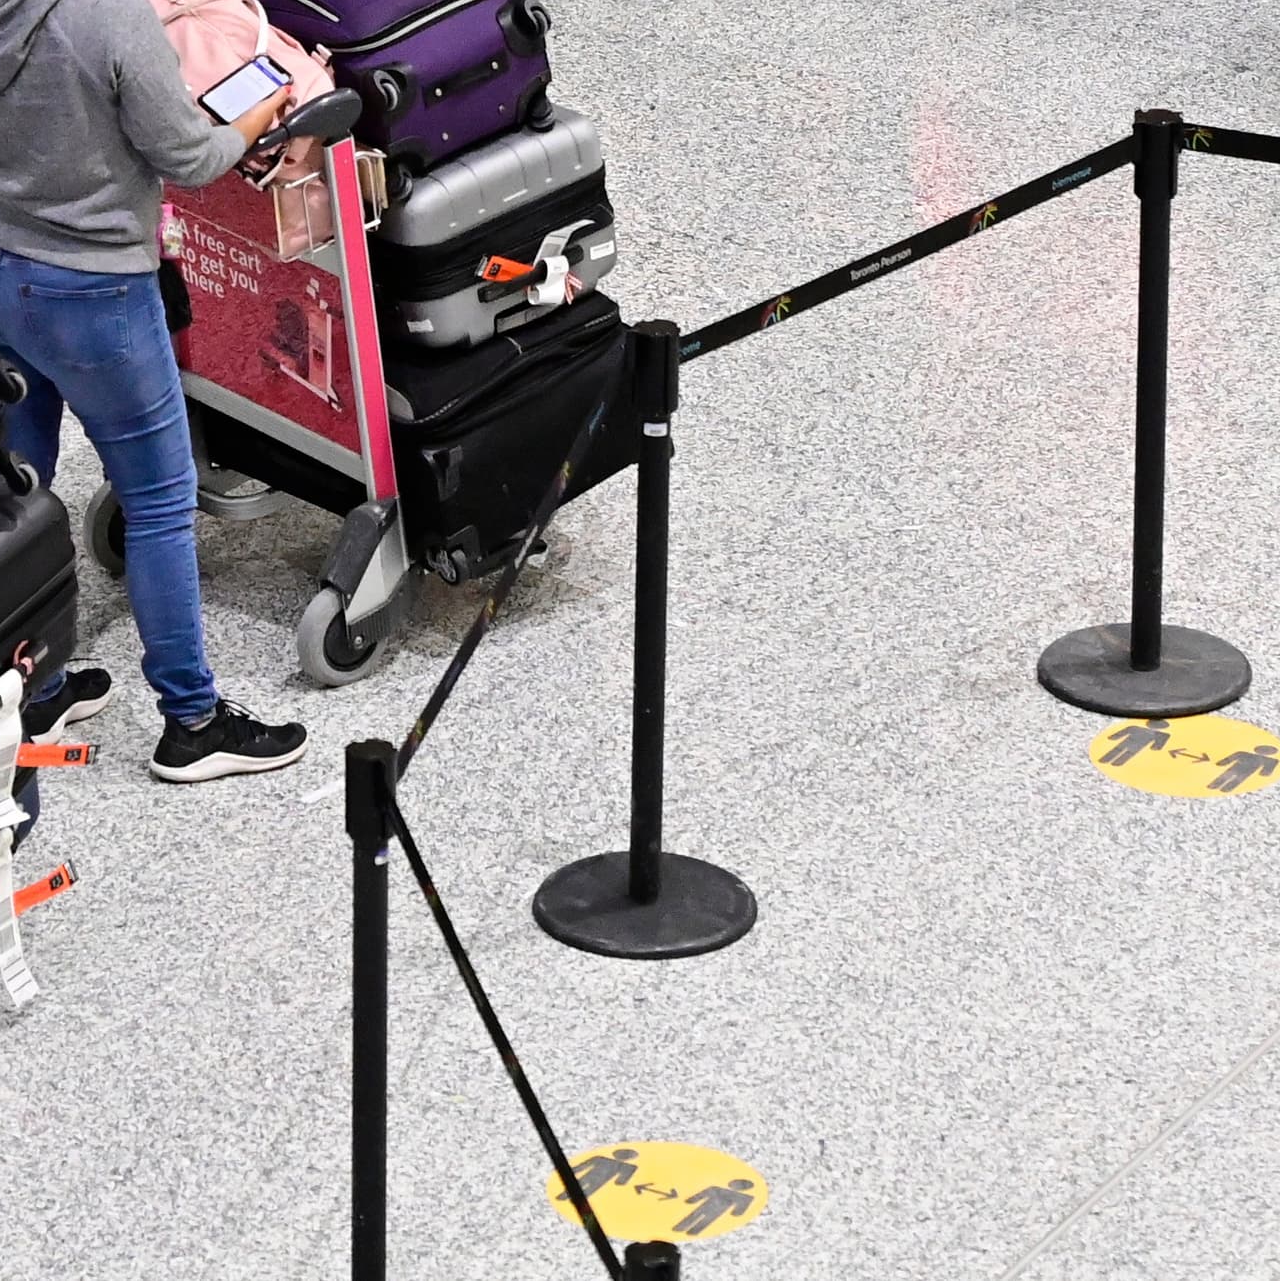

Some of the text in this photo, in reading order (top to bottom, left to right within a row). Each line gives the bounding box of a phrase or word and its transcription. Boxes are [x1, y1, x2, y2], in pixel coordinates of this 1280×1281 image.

[1052, 167, 1092, 191] bienvenue
[179, 218, 262, 274] A free cart
[181, 245, 259, 294] to get you
[182, 262, 224, 298] there
[850, 248, 912, 281] Toronto Pearson
